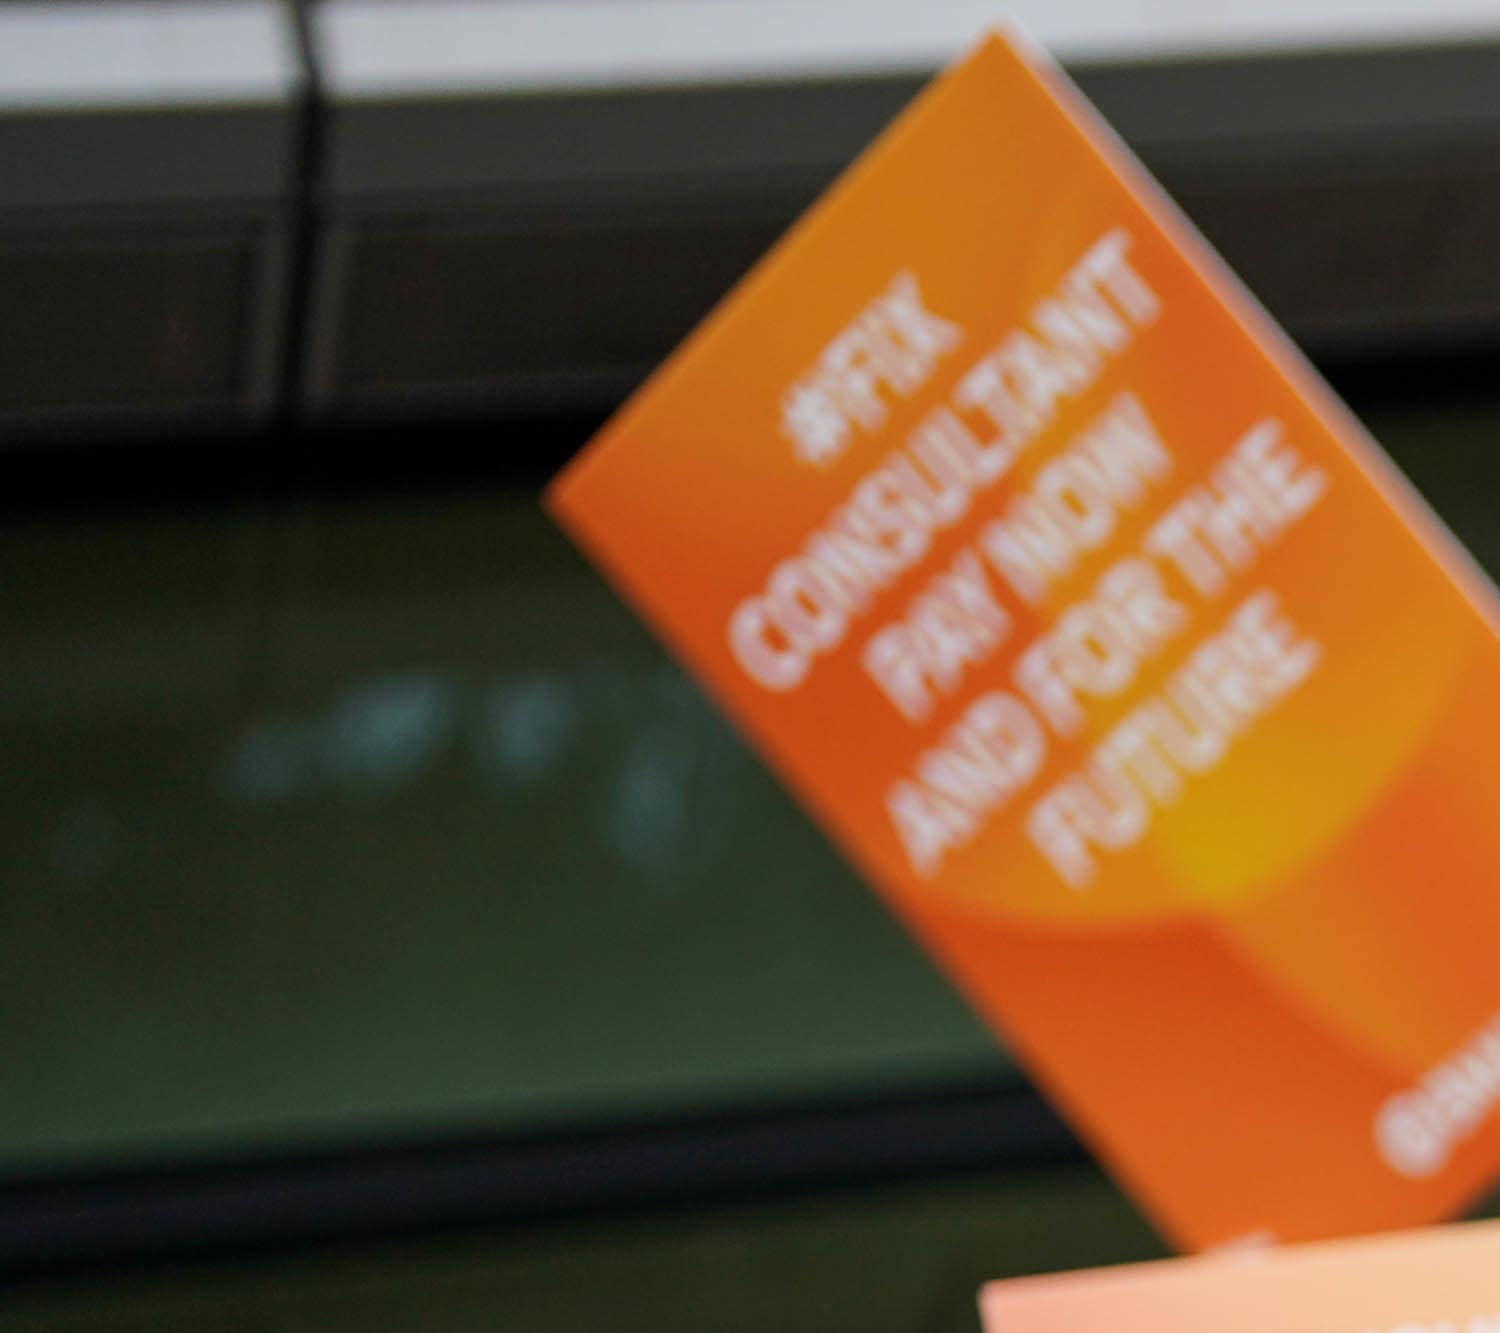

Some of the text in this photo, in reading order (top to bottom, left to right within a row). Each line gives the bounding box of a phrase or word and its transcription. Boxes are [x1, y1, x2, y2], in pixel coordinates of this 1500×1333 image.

[730, 230, 1160, 691] CONSULTANT
[780, 272, 960, 466] #FIX
[865, 396, 1171, 718] PAY NOW
[887, 420, 1325, 876] AND FOR THE
[1029, 592, 1320, 888] FUTURE
